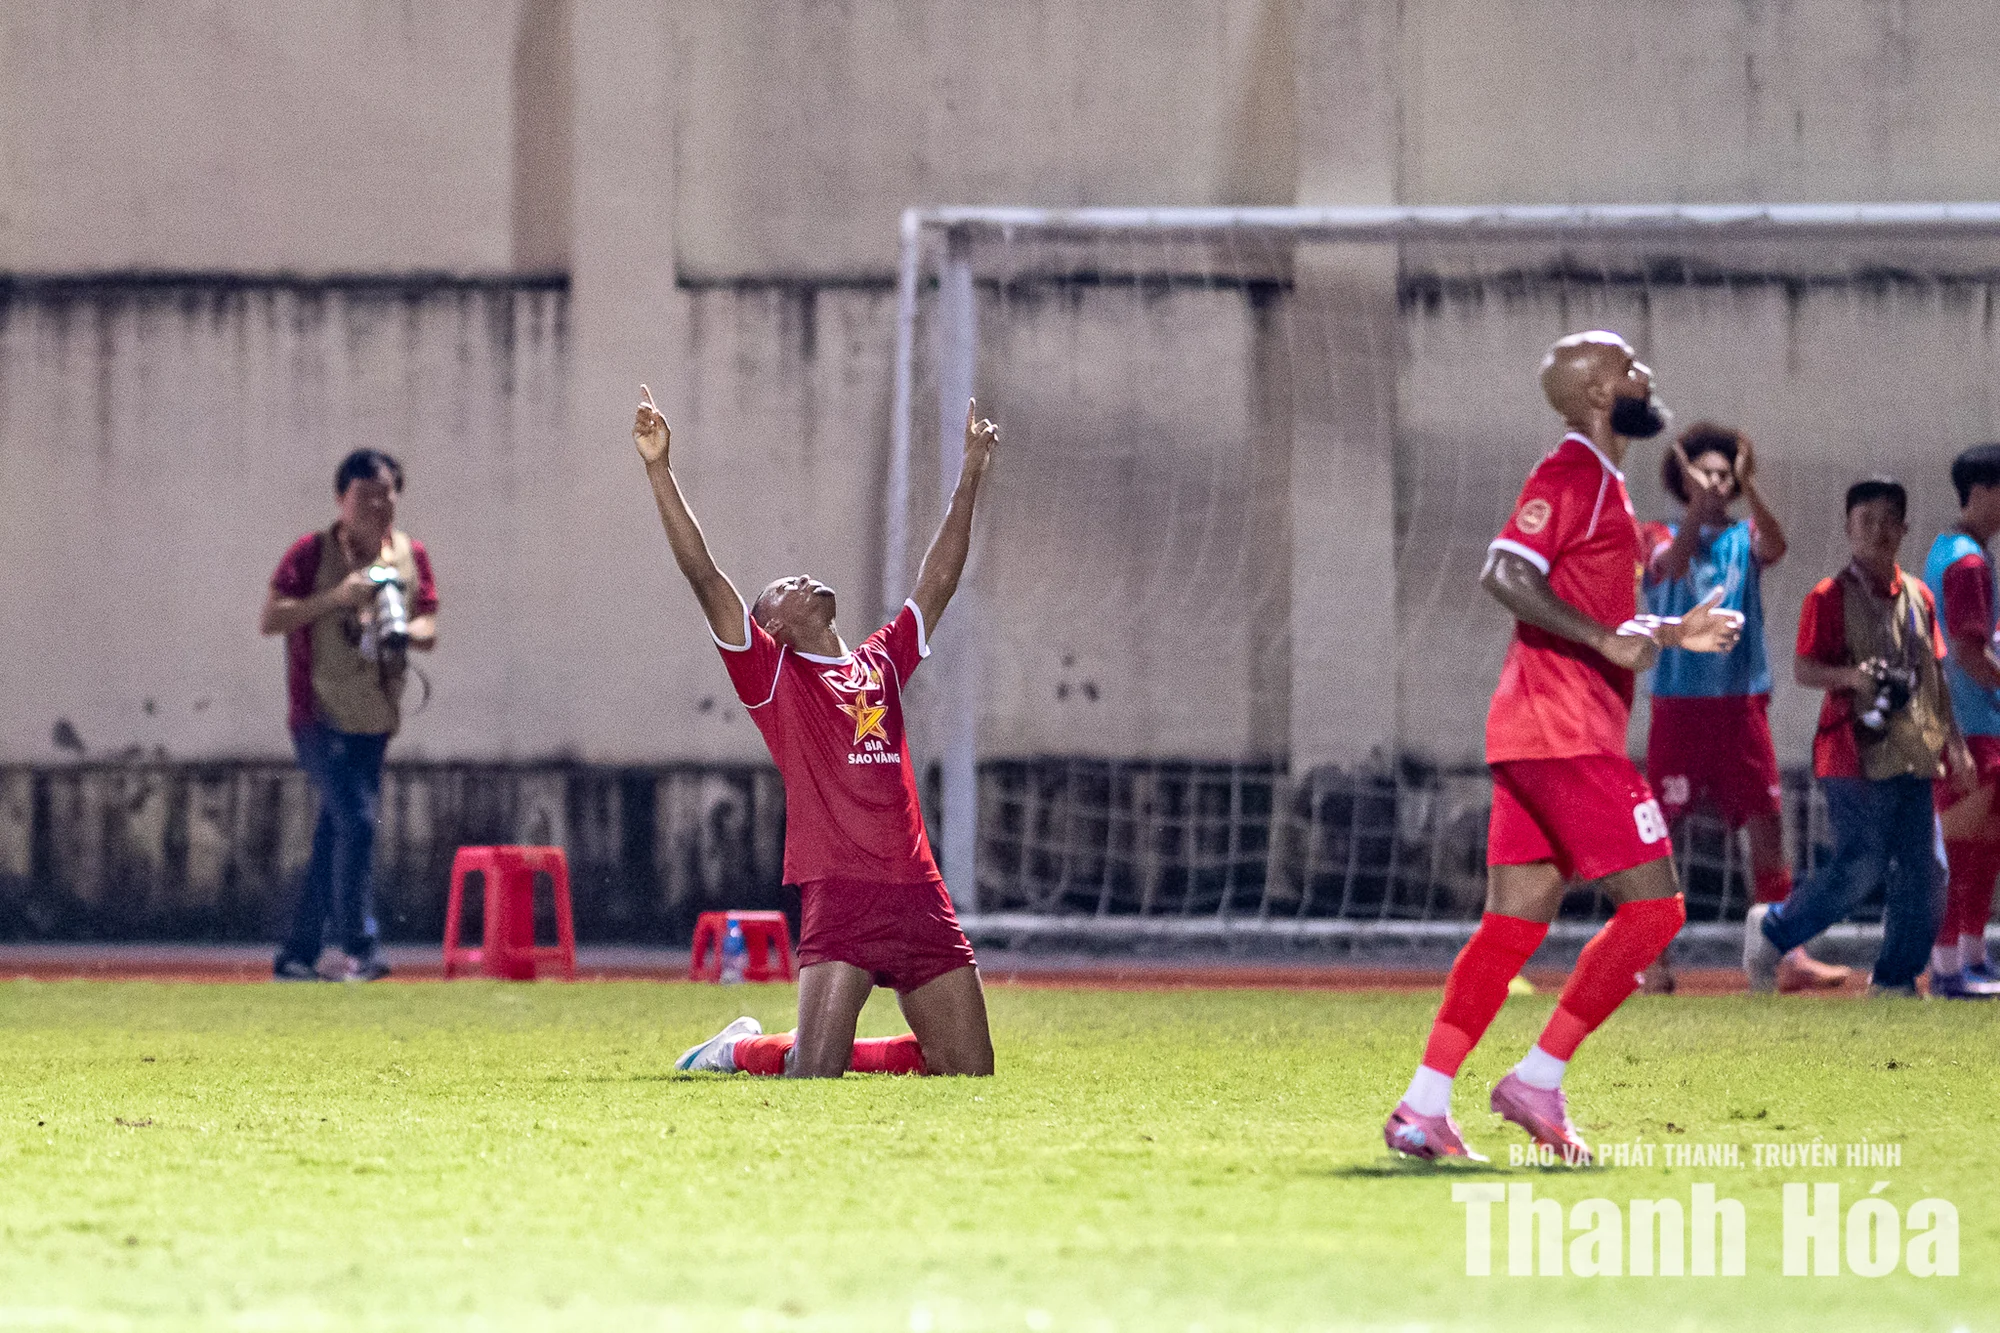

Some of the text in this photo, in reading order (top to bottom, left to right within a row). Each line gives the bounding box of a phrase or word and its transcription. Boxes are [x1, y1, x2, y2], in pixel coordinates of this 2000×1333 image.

[864, 739, 884, 752] BÌA
[847, 751, 901, 764] SAO VÀNG
